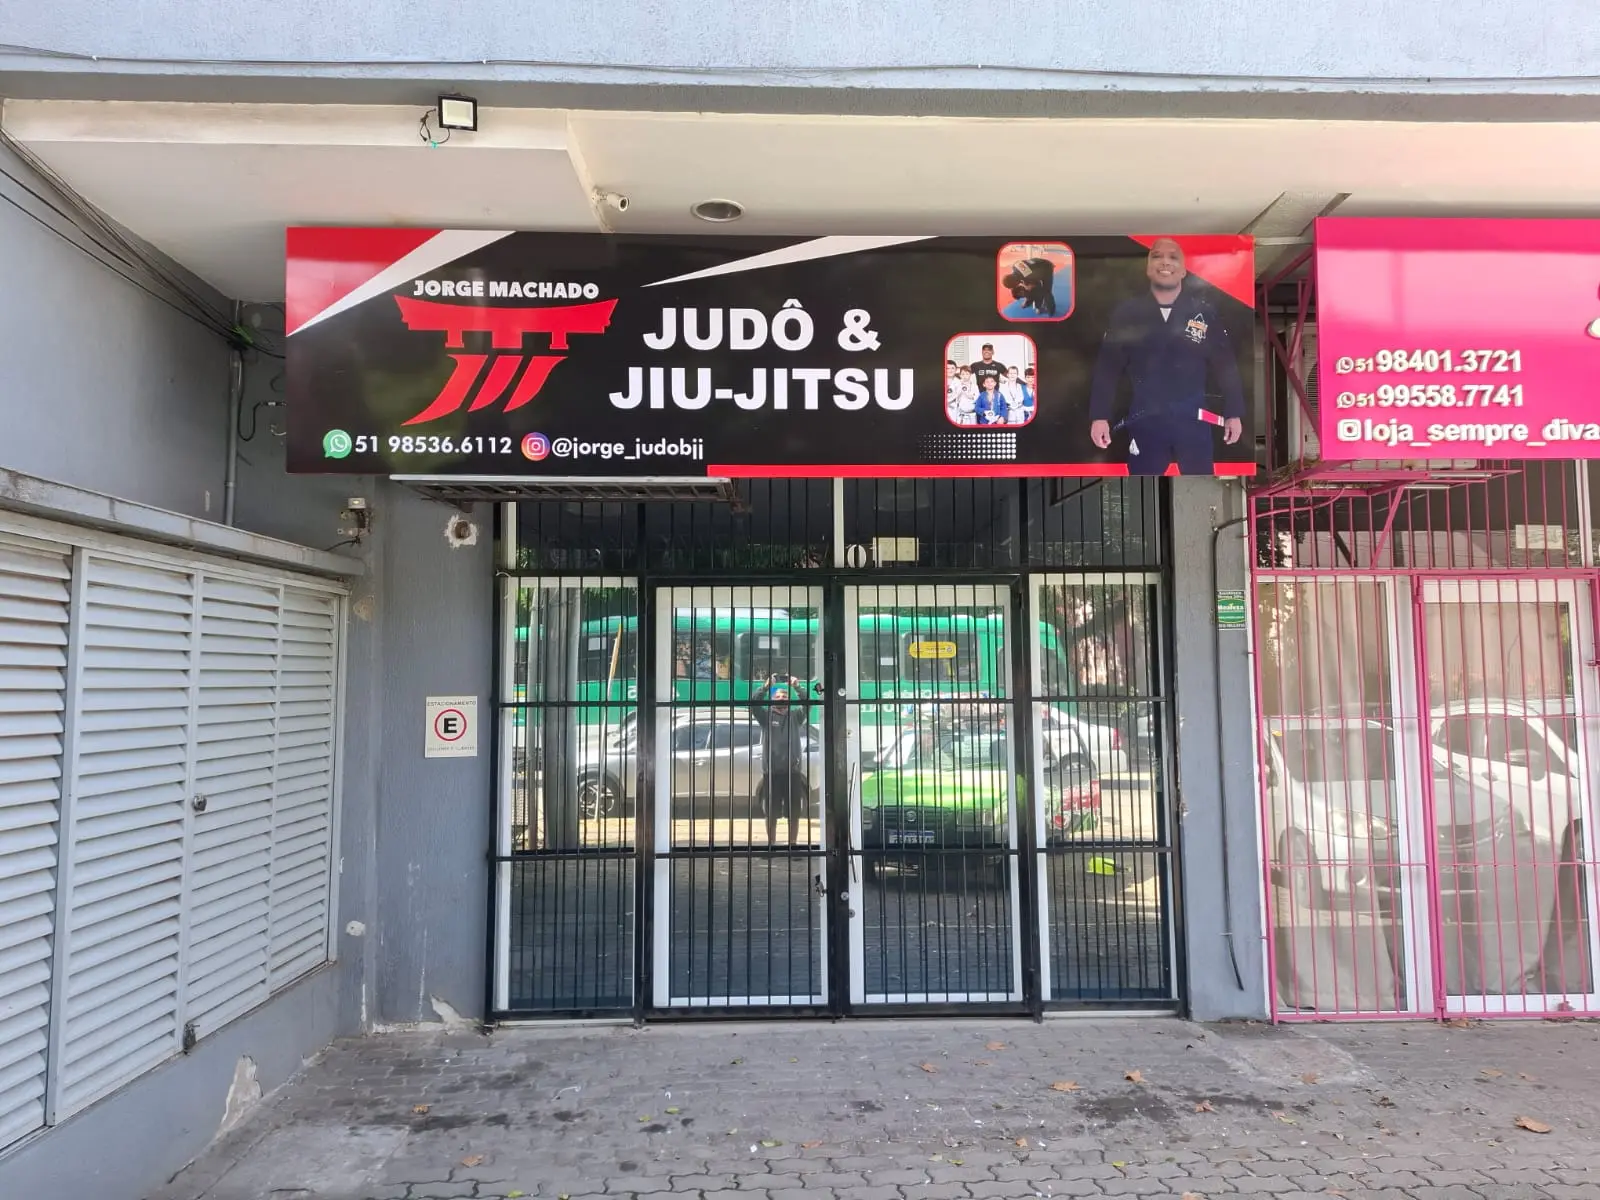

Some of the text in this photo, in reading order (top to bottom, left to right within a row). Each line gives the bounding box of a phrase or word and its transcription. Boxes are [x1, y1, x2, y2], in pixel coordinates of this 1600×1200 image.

[413, 280, 599, 299] JORGE MACHADO
[642, 298, 881, 352] JUDÔ &
[1355, 349, 1522, 373] 51 98401.3721
[608, 367, 914, 411] JIU-JITSU
[1356, 384, 1524, 407] 51 99558.7741
[355, 435, 512, 454] 51 98536.6112
[551, 437, 704, 460] @jorge_judobjj
[443, 717, 457, 733] E
